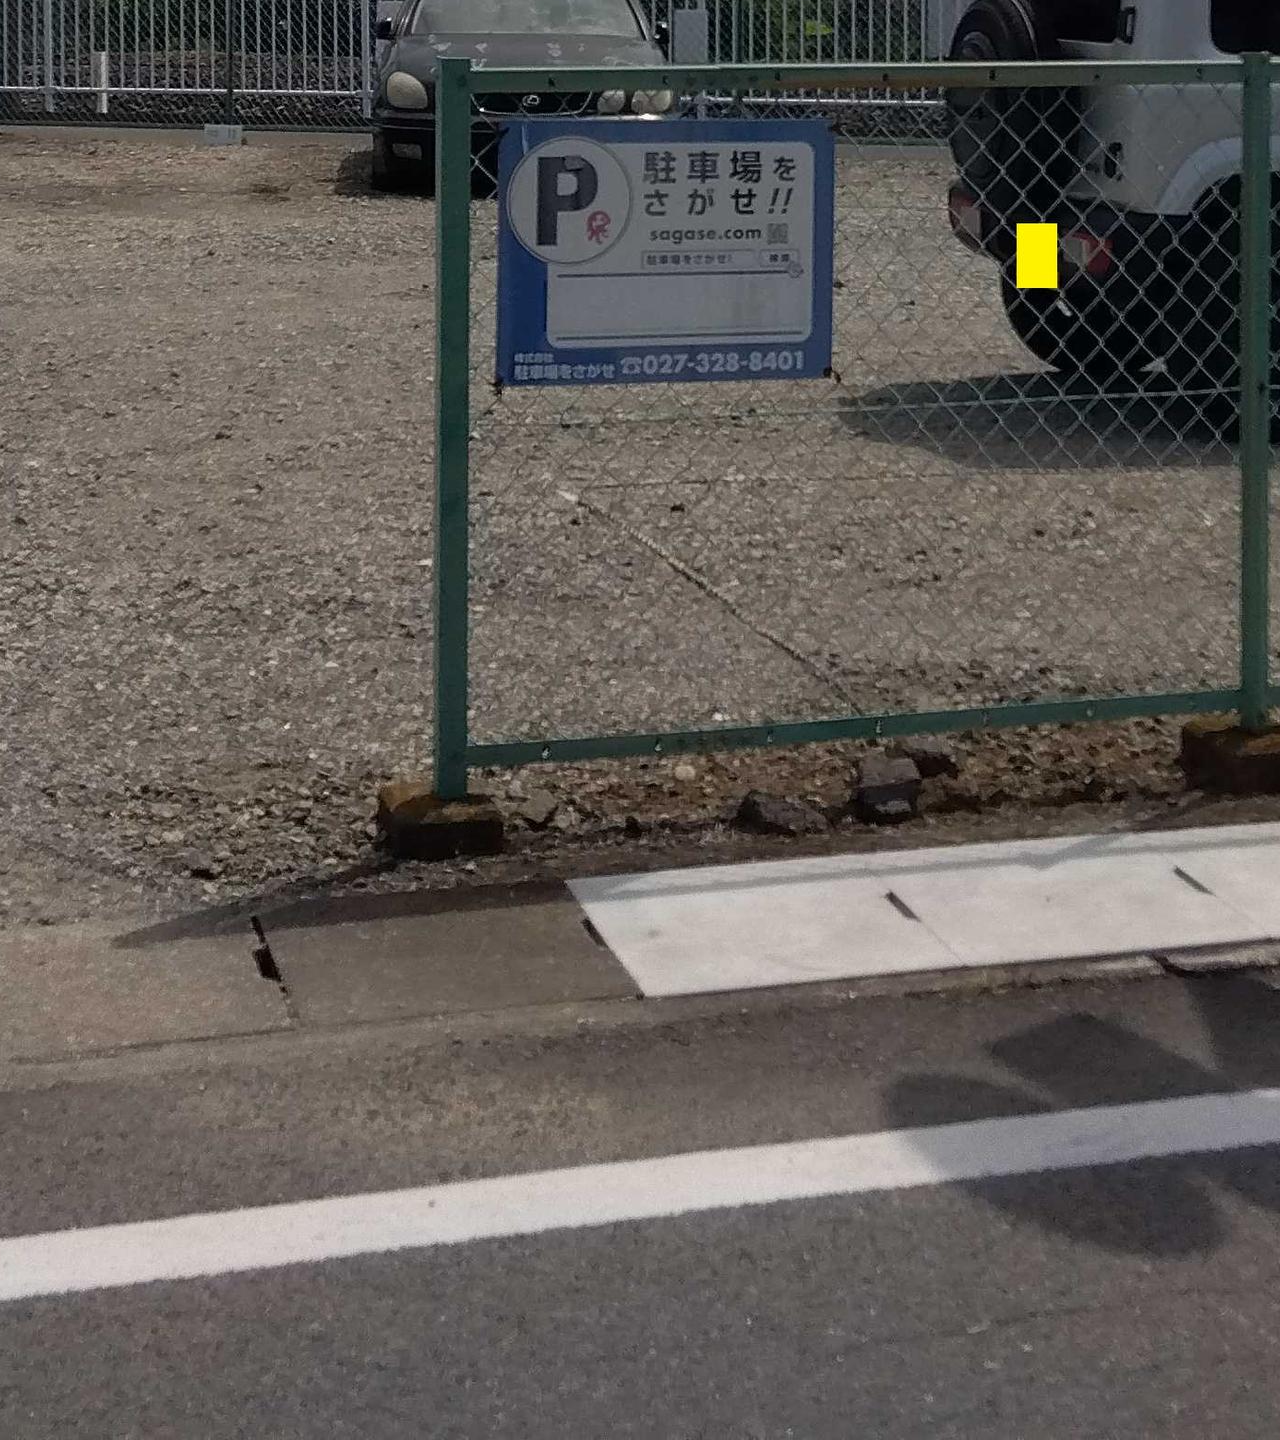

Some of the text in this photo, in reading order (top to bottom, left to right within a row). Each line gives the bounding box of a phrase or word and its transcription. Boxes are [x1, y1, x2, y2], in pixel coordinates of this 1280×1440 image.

[642, 151, 797, 185] 駐車場を
[536, 155, 599, 247] P
[649, 227, 762, 244] sagase.com
[642, 351, 805, 375] 027-328-8401
